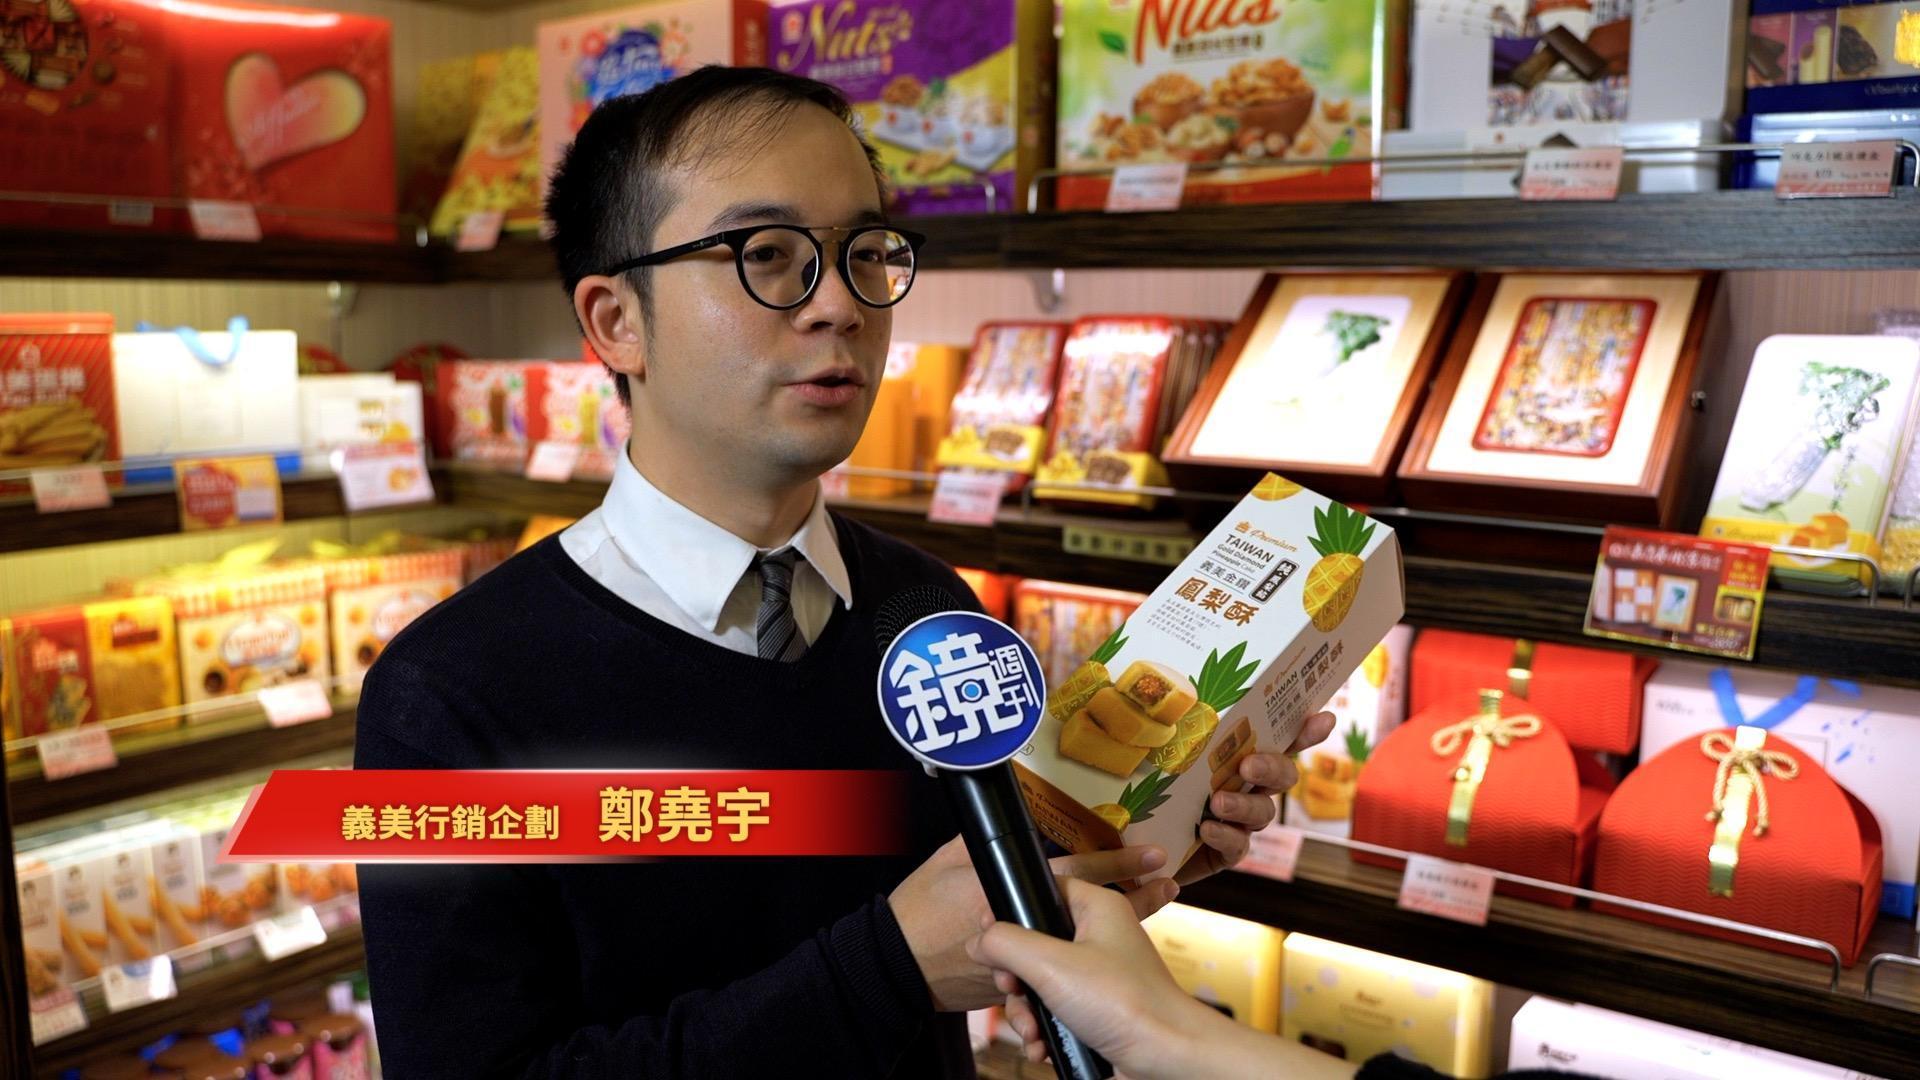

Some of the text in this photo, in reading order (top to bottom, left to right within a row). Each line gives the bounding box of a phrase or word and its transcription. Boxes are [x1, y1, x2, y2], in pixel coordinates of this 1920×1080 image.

[1217, 543, 1266, 570] Gold Diamond
[1225, 534, 1275, 563] TAIWAN
[1174, 576, 1260, 627] 鳳梨酥
[1265, 671, 1298, 708] TAIWAN
